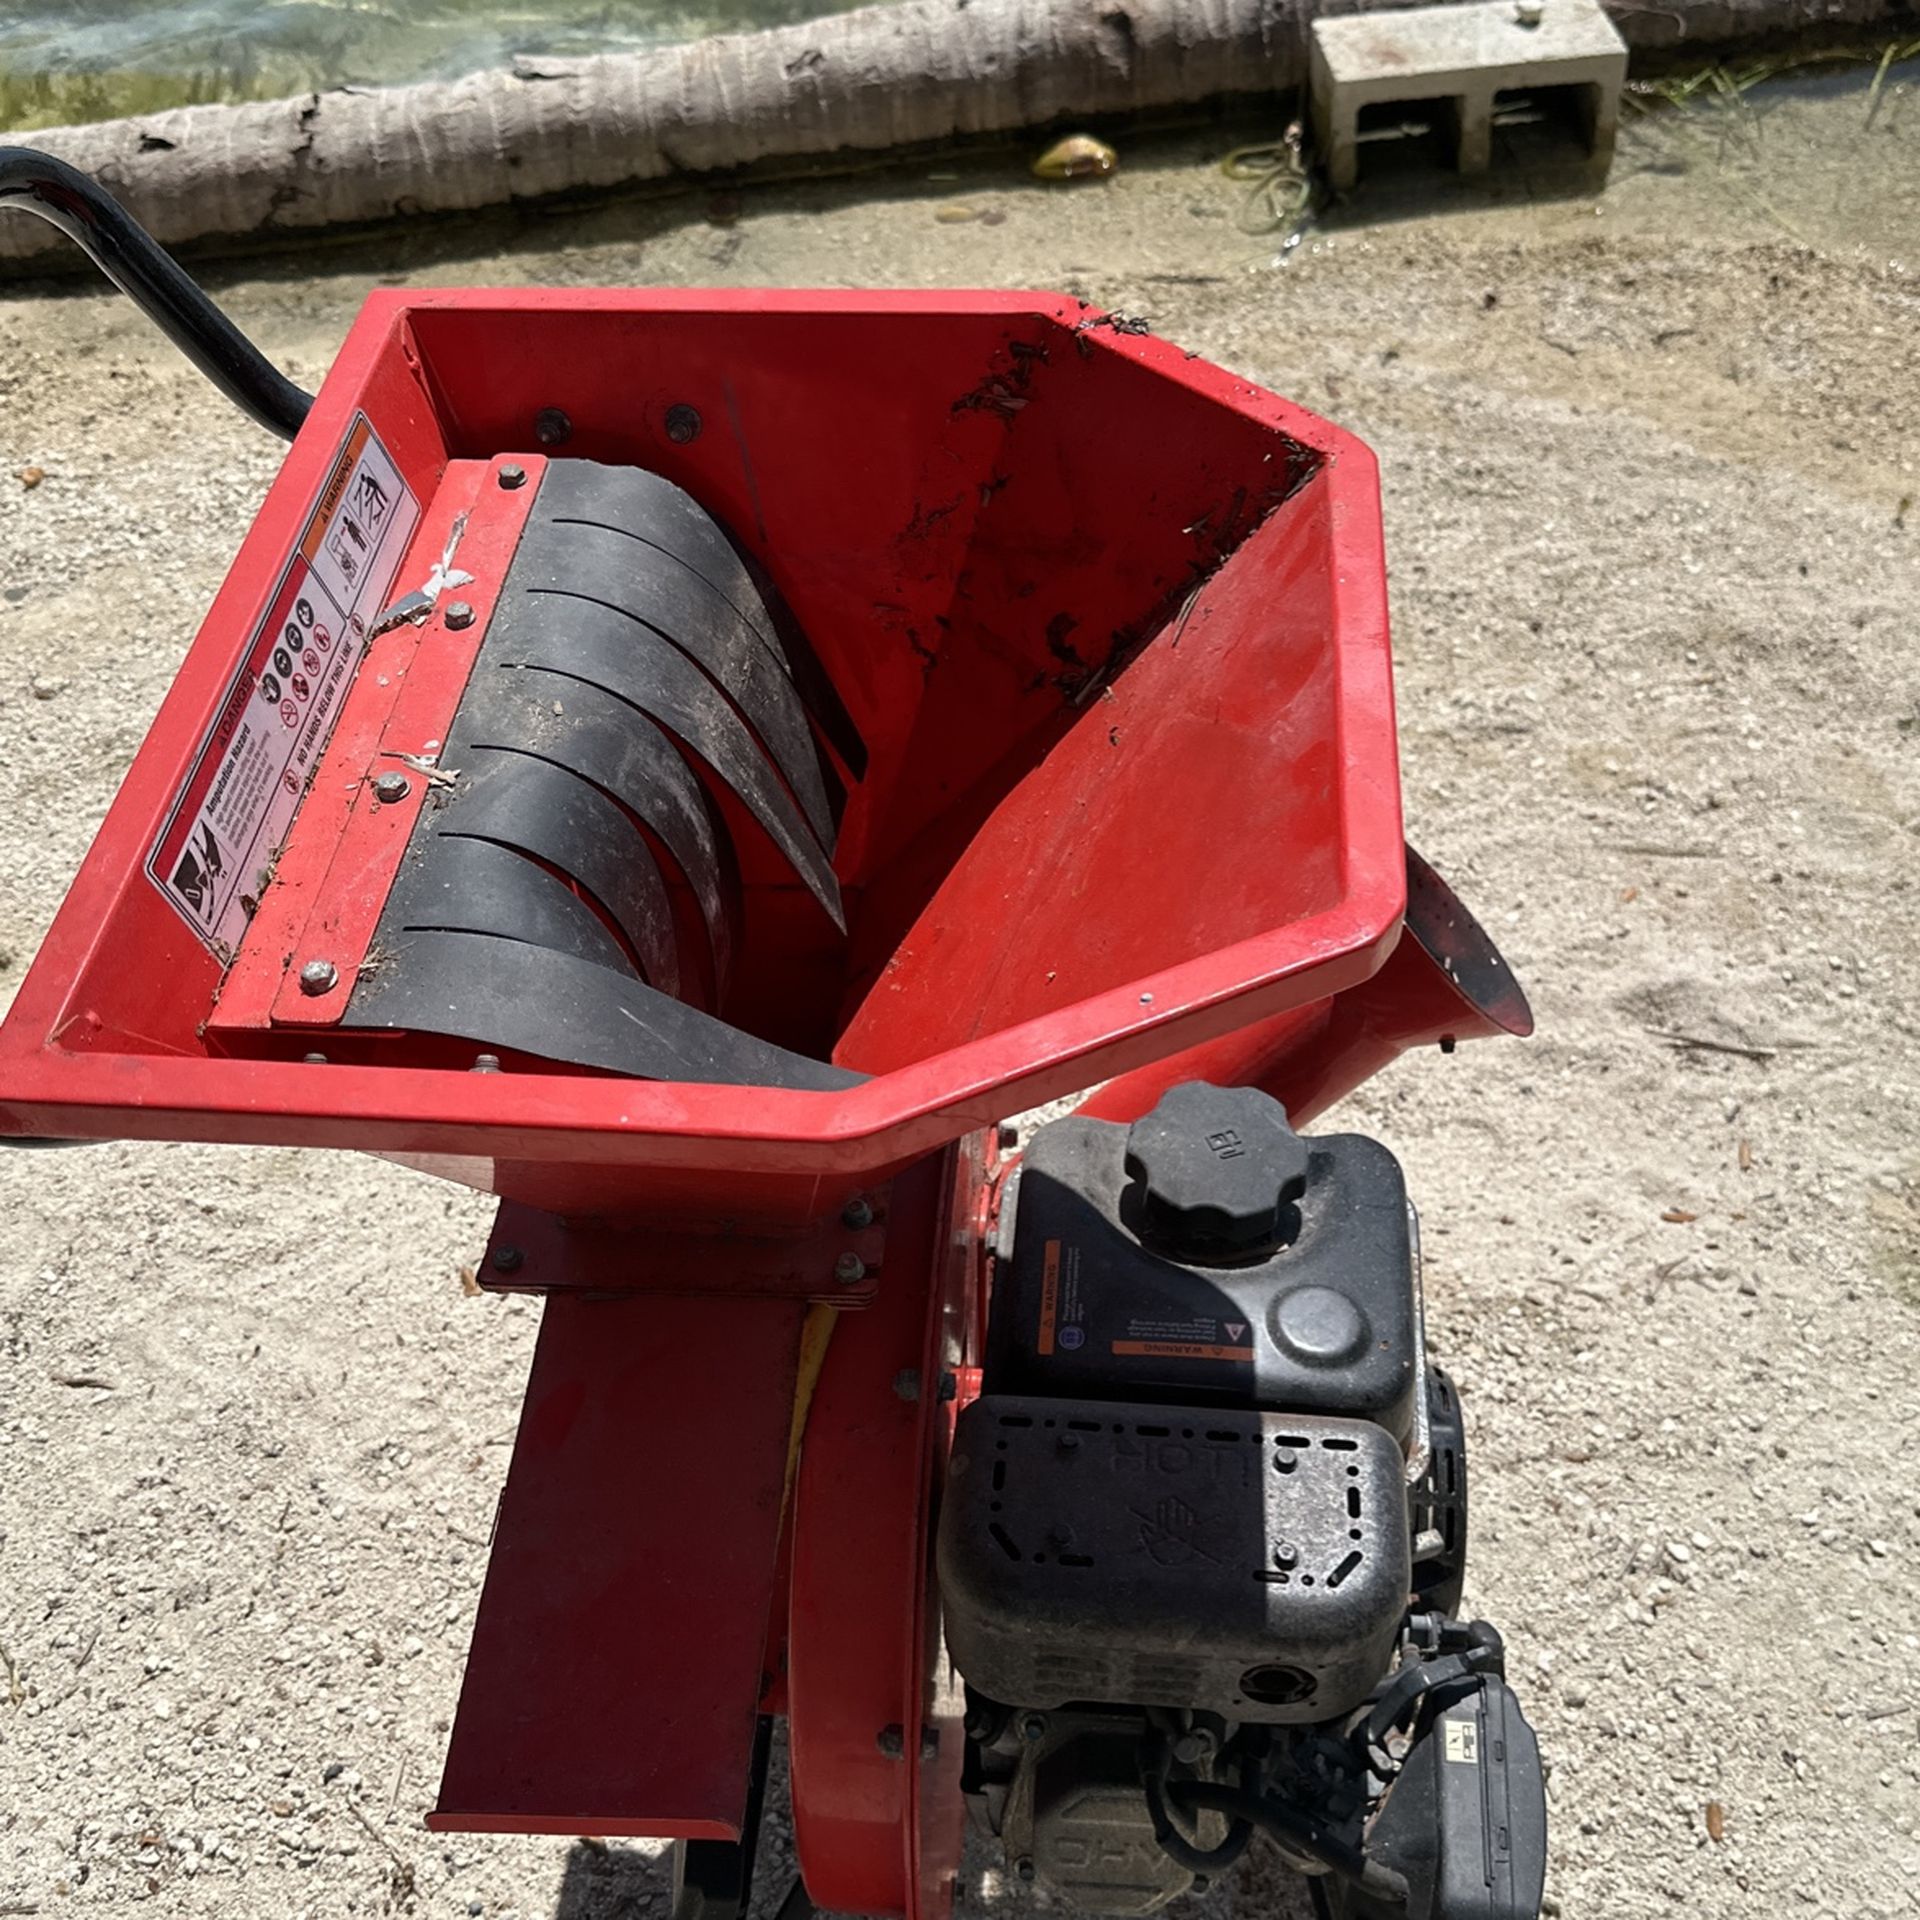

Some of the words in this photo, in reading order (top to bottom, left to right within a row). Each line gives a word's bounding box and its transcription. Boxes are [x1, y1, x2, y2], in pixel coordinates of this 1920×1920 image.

[325, 454, 353, 512] WARNING
[222, 670, 256, 733] DANGER
[297, 748, 308, 766] NO
[303, 714, 322, 751] HANDS
[317, 683, 336, 718] BELOW
[331, 661, 345, 685] THIS
[340, 640, 353, 664] LINE
[206, 759, 236, 816] Amputation
[231, 722, 251, 758] Hazard
[1044, 1263, 1057, 1312] WARNING
[1143, 1343, 1203, 1355] WARNING
